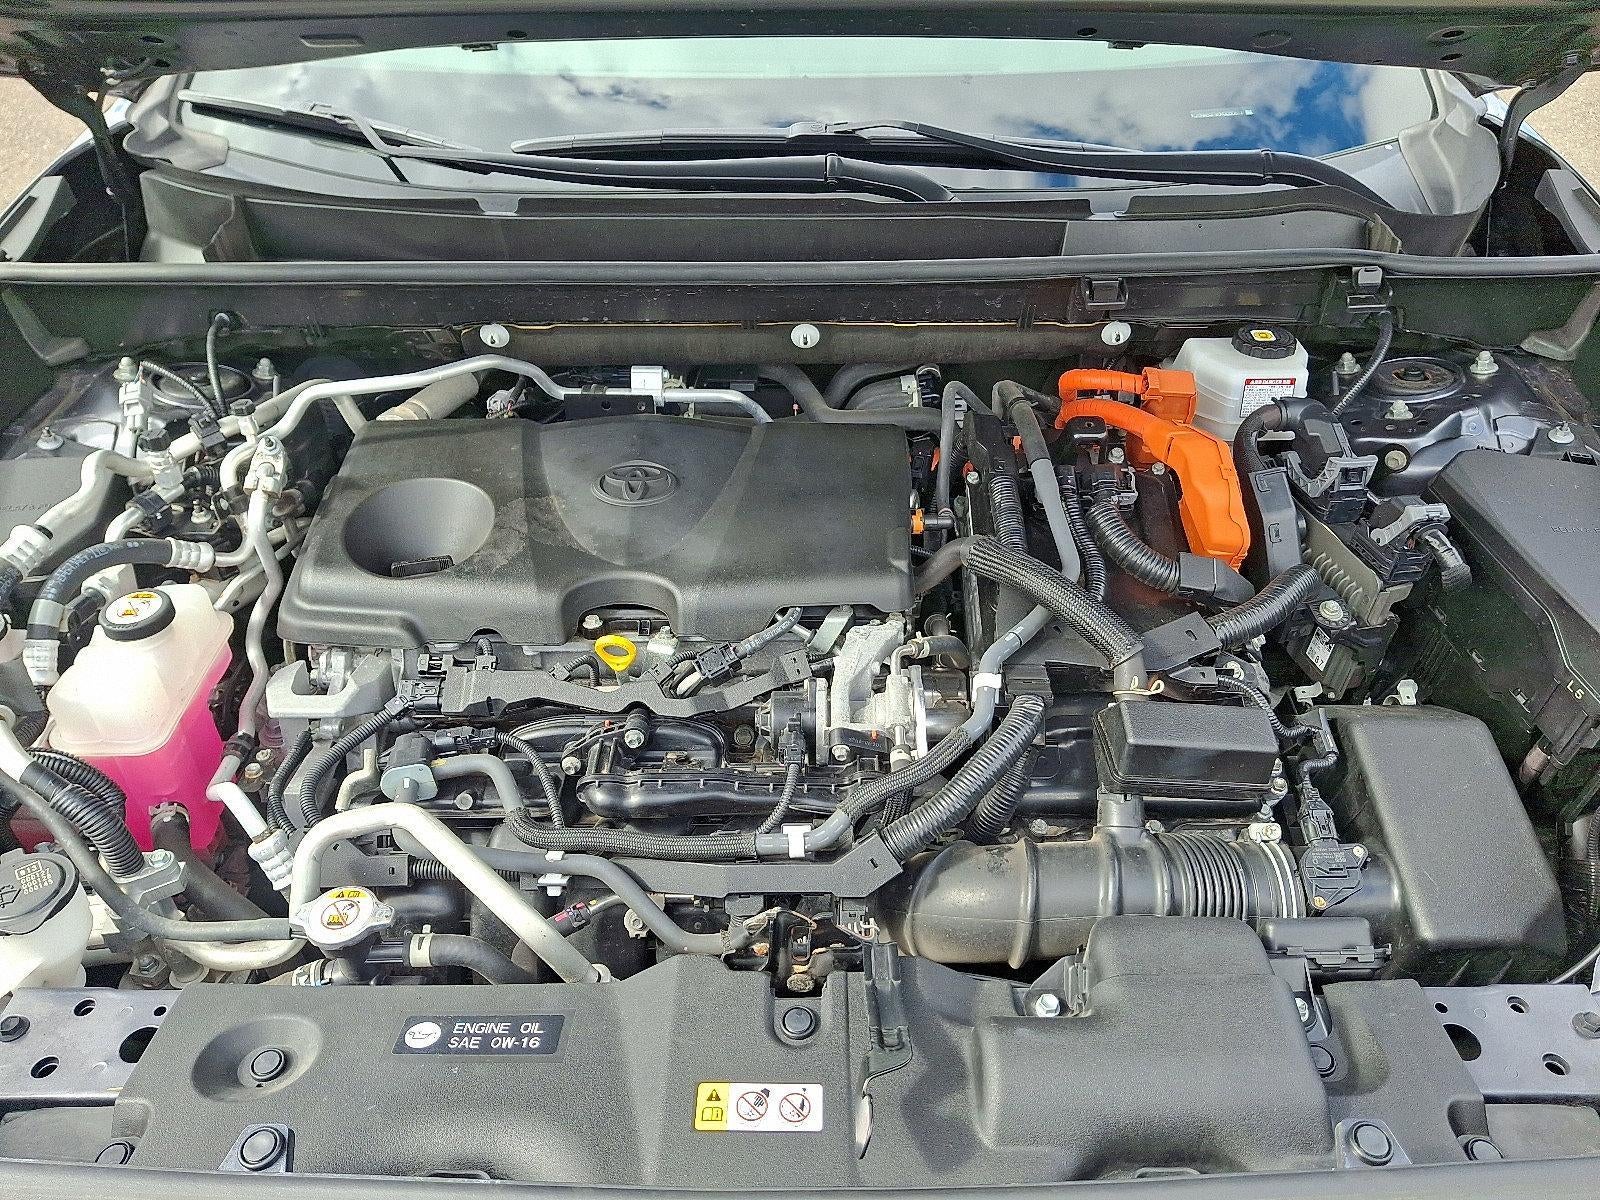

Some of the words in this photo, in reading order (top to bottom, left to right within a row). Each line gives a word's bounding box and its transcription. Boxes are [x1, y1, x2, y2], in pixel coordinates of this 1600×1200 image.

[1566, 679, 1585, 700] L5
[452, 1022, 512, 1034] ENGINE
[519, 1022, 545, 1034] OIL
[447, 1036, 482, 1049] SAE
[490, 1036, 541, 1049] 0W-16
